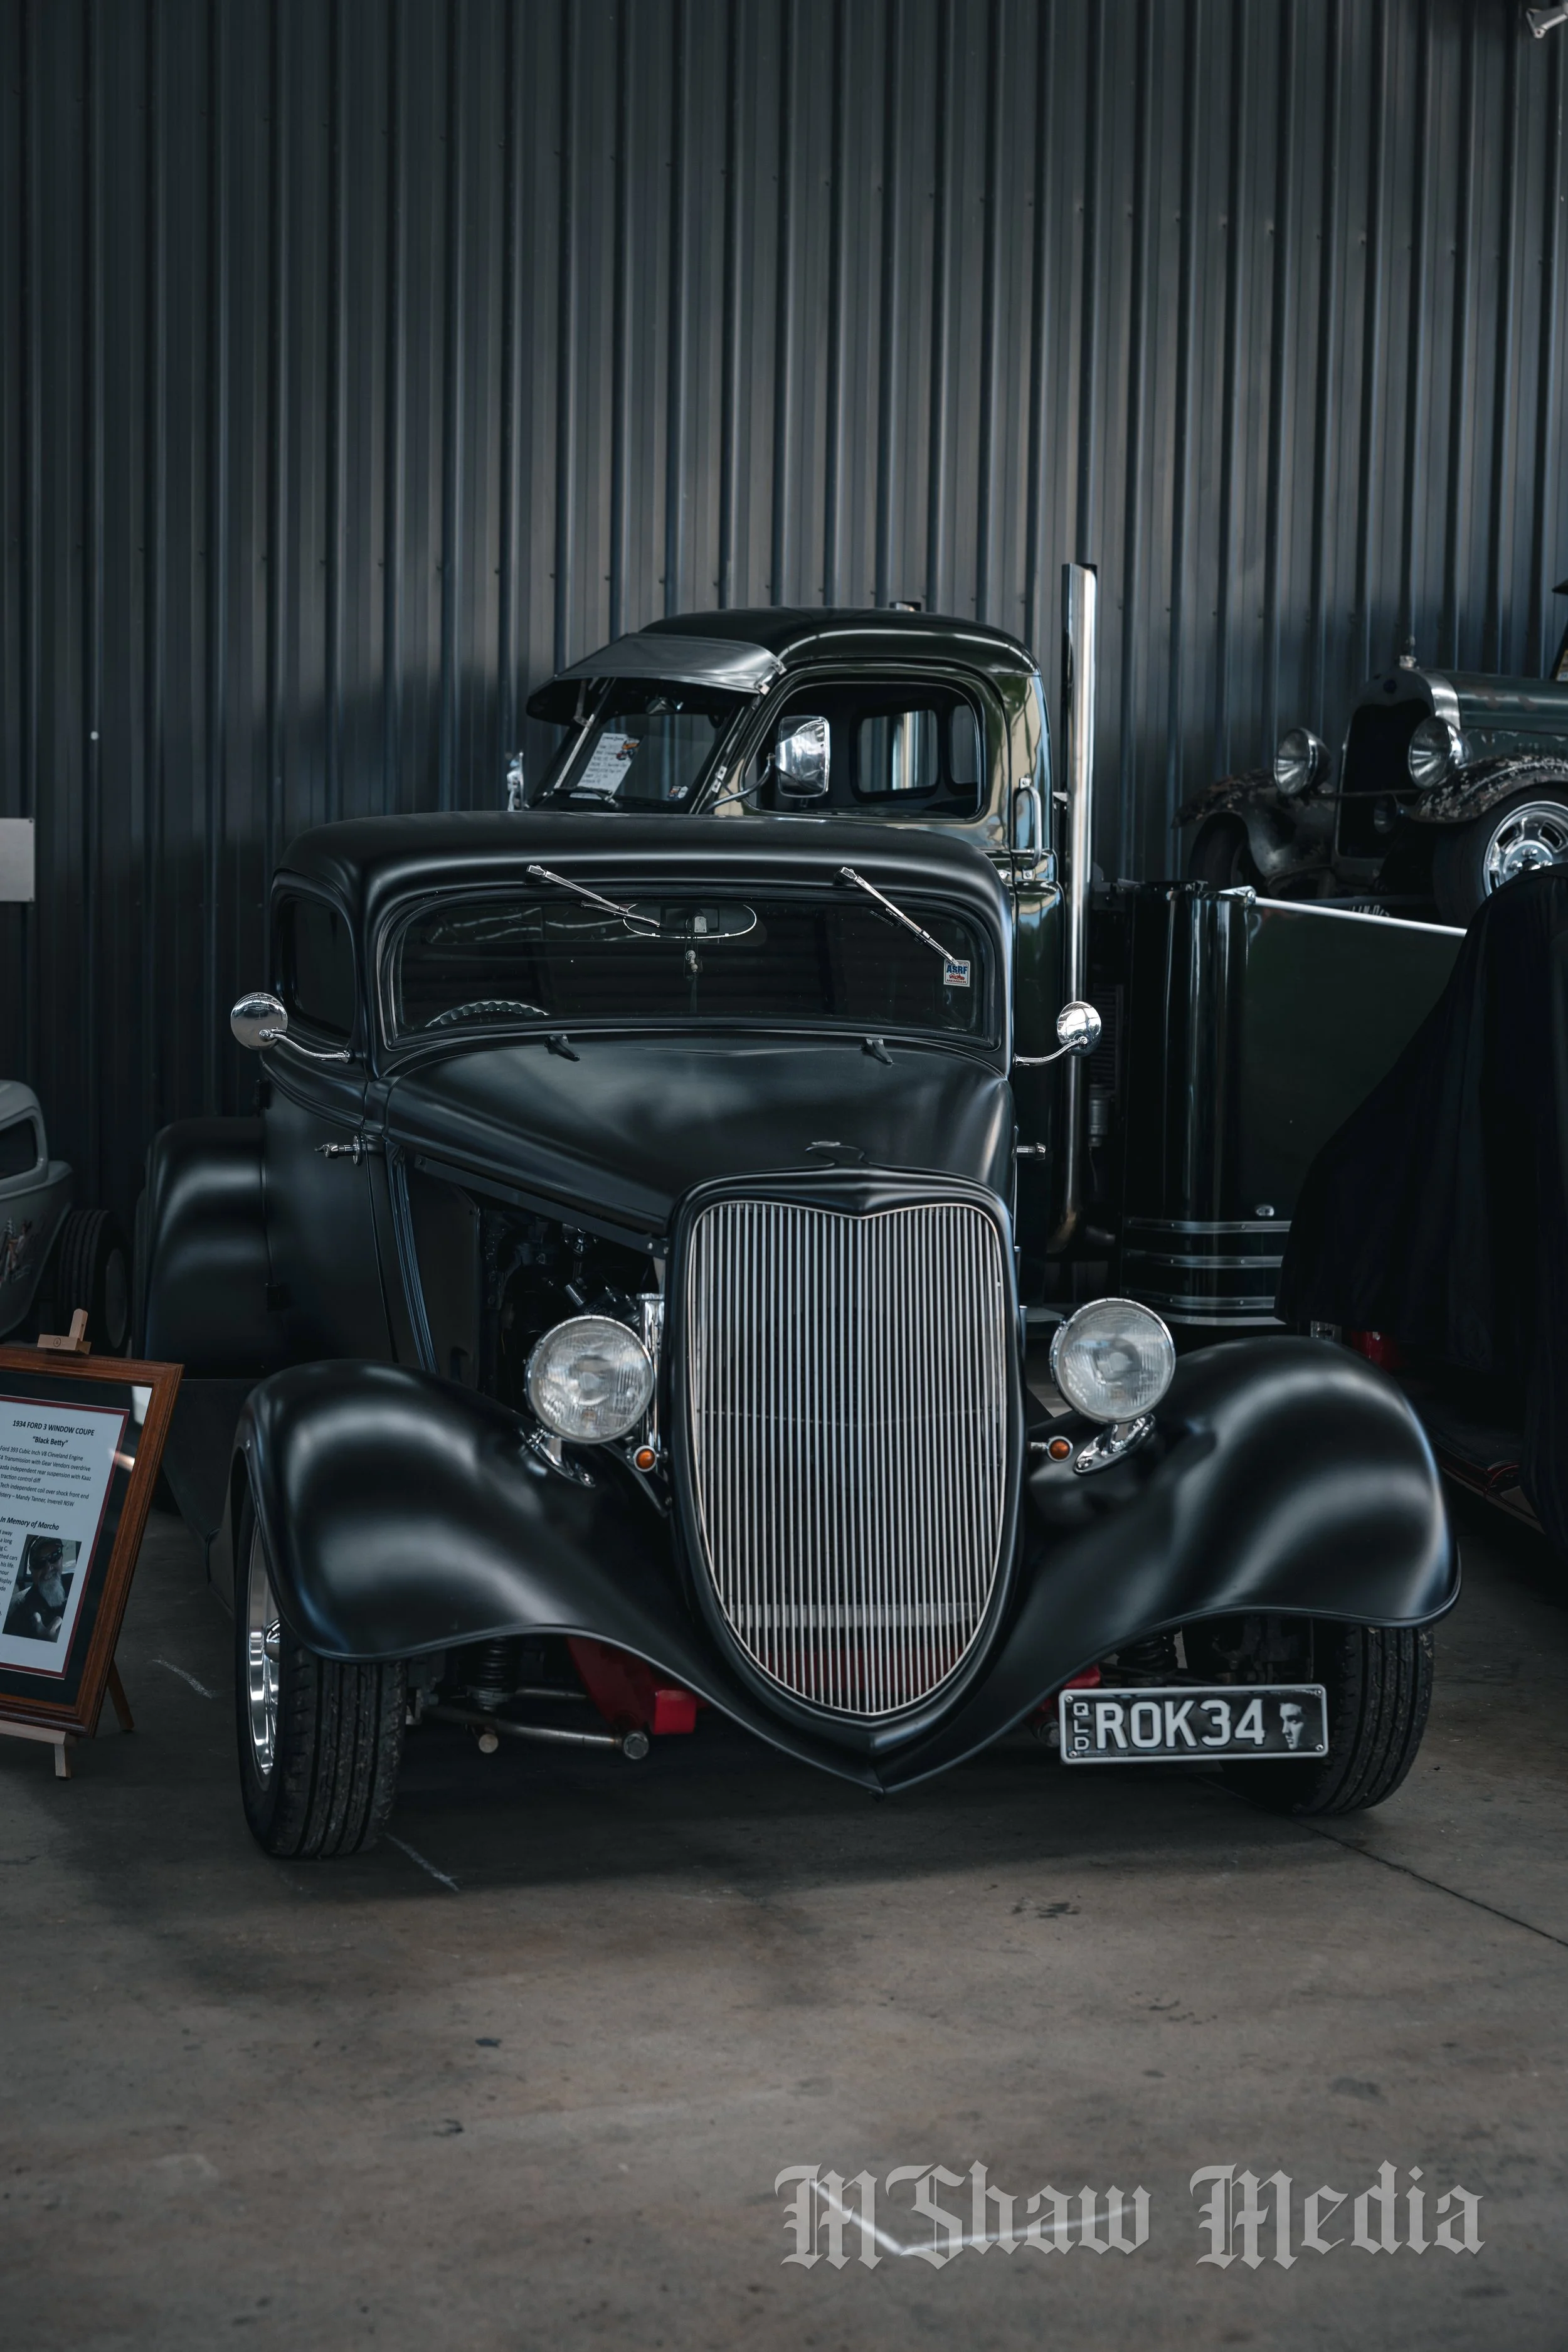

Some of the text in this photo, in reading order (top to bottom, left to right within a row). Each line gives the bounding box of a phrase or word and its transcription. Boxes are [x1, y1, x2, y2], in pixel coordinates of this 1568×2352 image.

[946, 965, 967, 974] ASRF
[27, 1421, 43, 1429] FORD
[48, 1424, 75, 1434] WINDOW
[75, 1428, 95, 1436] COUPE
[4, 1455, 31, 1464] Transmission
[48, 1451, 69, 1459] Cleveland
[10, 1465, 37, 1475] independent
[10, 1483, 37, 1492] independent
[16, 1493, 31, 1502] Mandy
[6, 1517, 30, 1527] Memory
[31, 1520, 38, 1528] of
[38, 1522, 60, 1530] Marcho
[1073, 1702, 1089, 1751] QLD
[1095, 1698, 1266, 1750] ROK34
